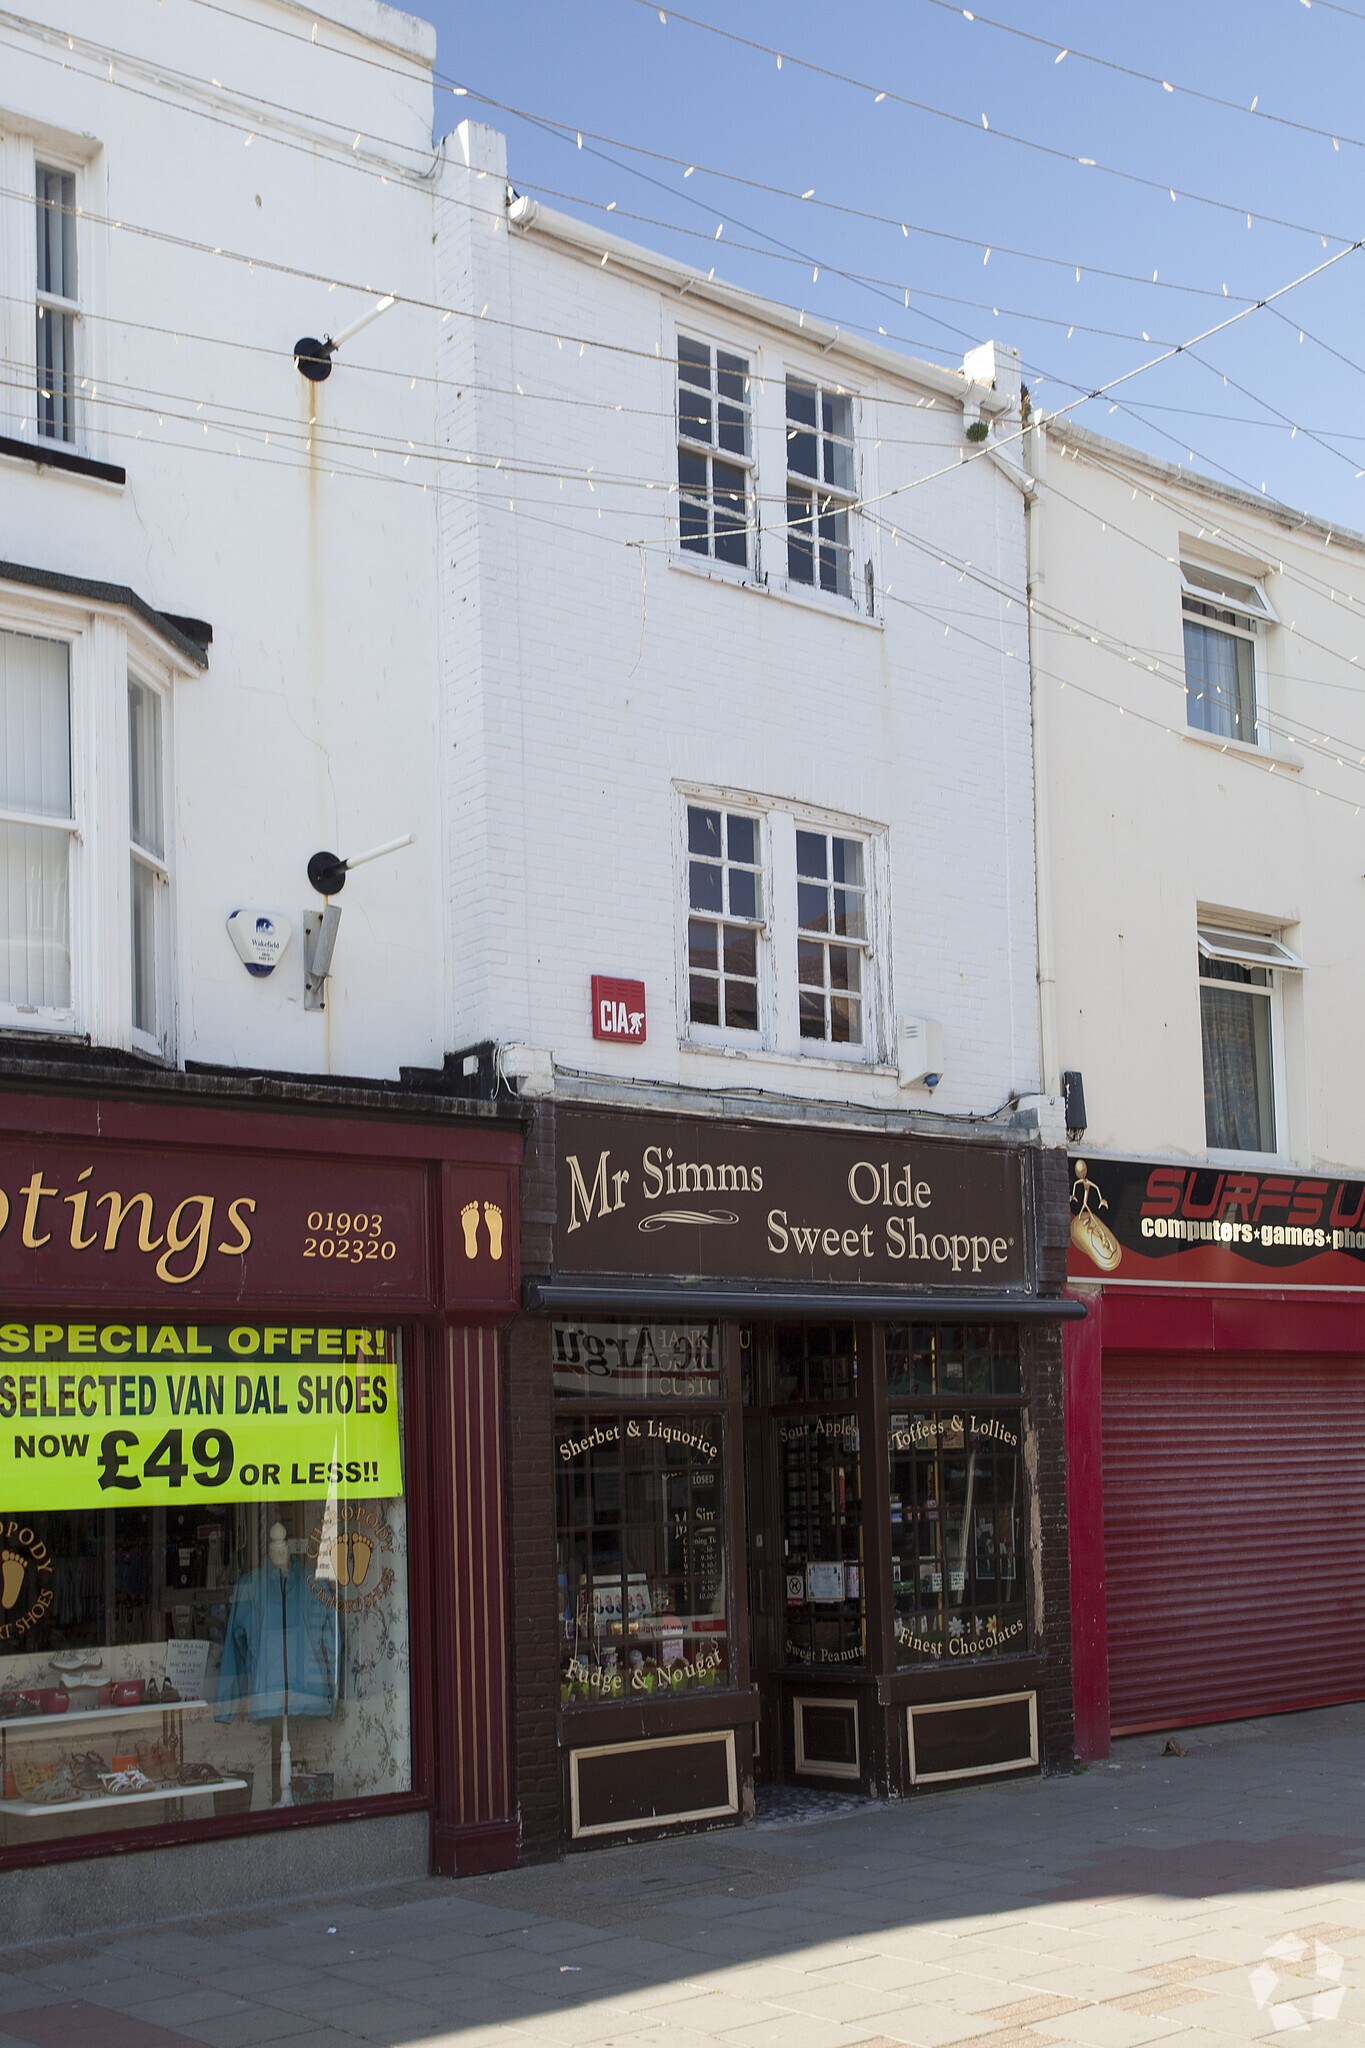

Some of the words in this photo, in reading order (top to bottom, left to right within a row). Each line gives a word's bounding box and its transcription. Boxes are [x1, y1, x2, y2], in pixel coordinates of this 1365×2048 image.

[251, 939, 279, 949] Wakefield
[600, 999, 629, 1034] CIA
[564, 1148, 630, 1235] Mr
[641, 1144, 764, 1200] Simms
[846, 1160, 933, 1209] Olde
[0, 1164, 258, 1285] tings
[306, 1209, 383, 1238] 01903
[766, 1207, 875, 1258] Sweet
[1140, 1217, 1253, 1244] computers
[1261, 1224, 1325, 1247] games
[303, 1236, 397, 1265] 202320
[0, 1323, 212, 1354] SPECIAL
[228, 1326, 385, 1356] OFFER!
[0, 1375, 156, 1418] SELECTED
[166, 1375, 224, 1416] VAN
[235, 1375, 288, 1415] DAL
[297, 1375, 387, 1415] SHOES
[559, 1424, 620, 1462] Sherbet
[626, 1419, 642, 1438] &
[647, 1419, 718, 1458] Liquorice
[779, 1423, 810, 1443] Sour
[815, 1418, 860, 1438] Apples
[891, 1419, 945, 1451] Toffees
[950, 1414, 965, 1432] &
[970, 1415, 1018, 1447] Lollies
[14, 1433, 89, 1459] NOW
[97, 1428, 234, 1491] £49
[239, 1463, 281, 1486] OR
[291, 1461, 379, 1484] LESS!!
[0, 1520, 54, 1574] PODY
[15, 1588, 54, 1634] SHOES
[785, 1640, 816, 1663] Sweet
[820, 1644, 865, 1664] Peanuts
[898, 1626, 943, 1655] Finest
[948, 1617, 1024, 1656] Chocolates
[565, 1657, 623, 1694] Fudge
[631, 1669, 649, 1690] &
[656, 1648, 723, 1687] Nougat
